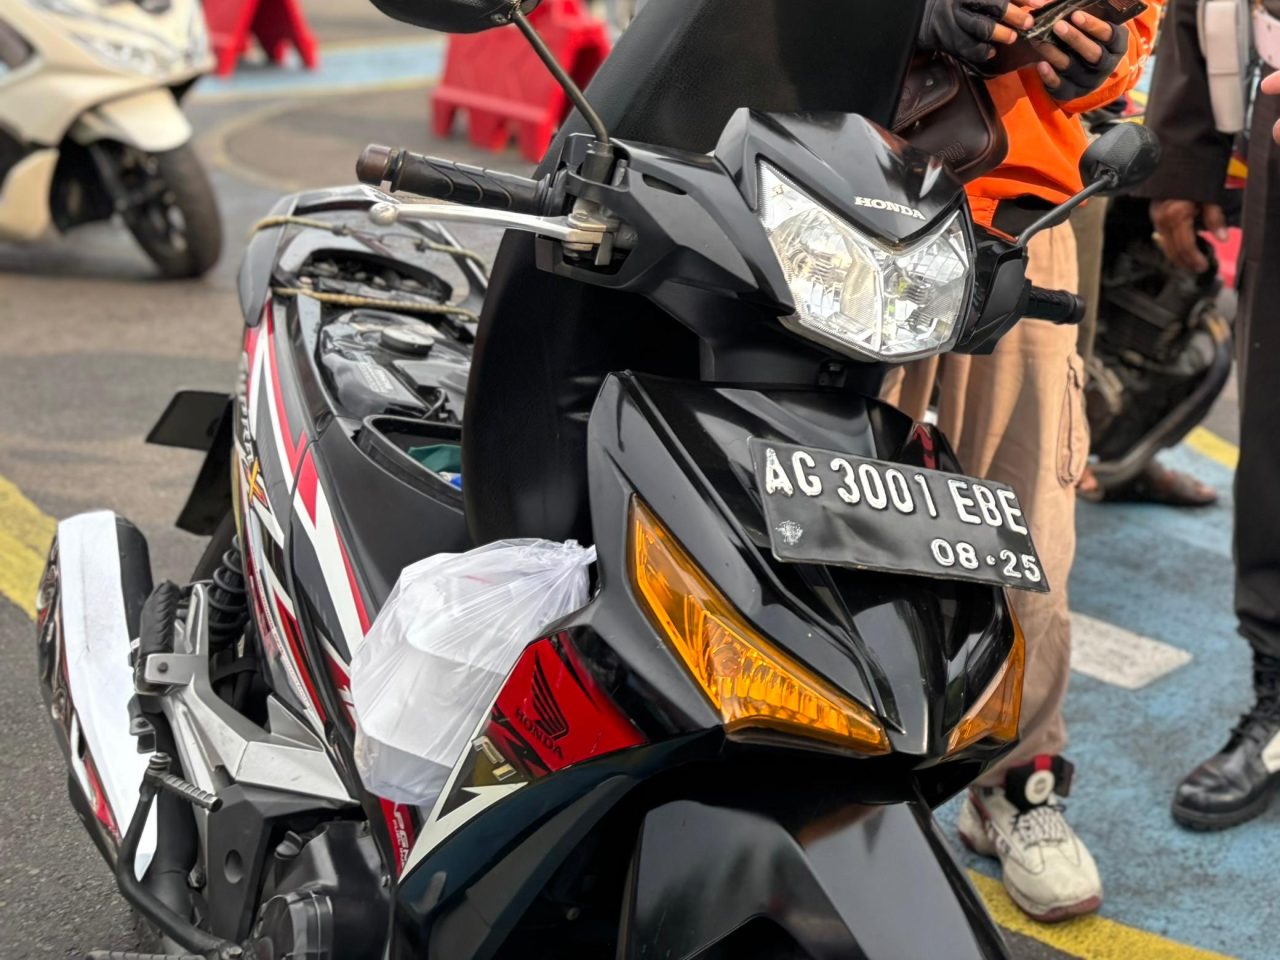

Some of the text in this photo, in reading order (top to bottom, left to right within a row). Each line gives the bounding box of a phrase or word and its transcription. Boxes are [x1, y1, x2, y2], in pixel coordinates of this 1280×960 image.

[854, 196, 927, 220] HONDA
[765, 447, 1029, 535] AG 3001 EBE
[515, 706, 564, 759] HONDA
[471, 735, 517, 781] FI
